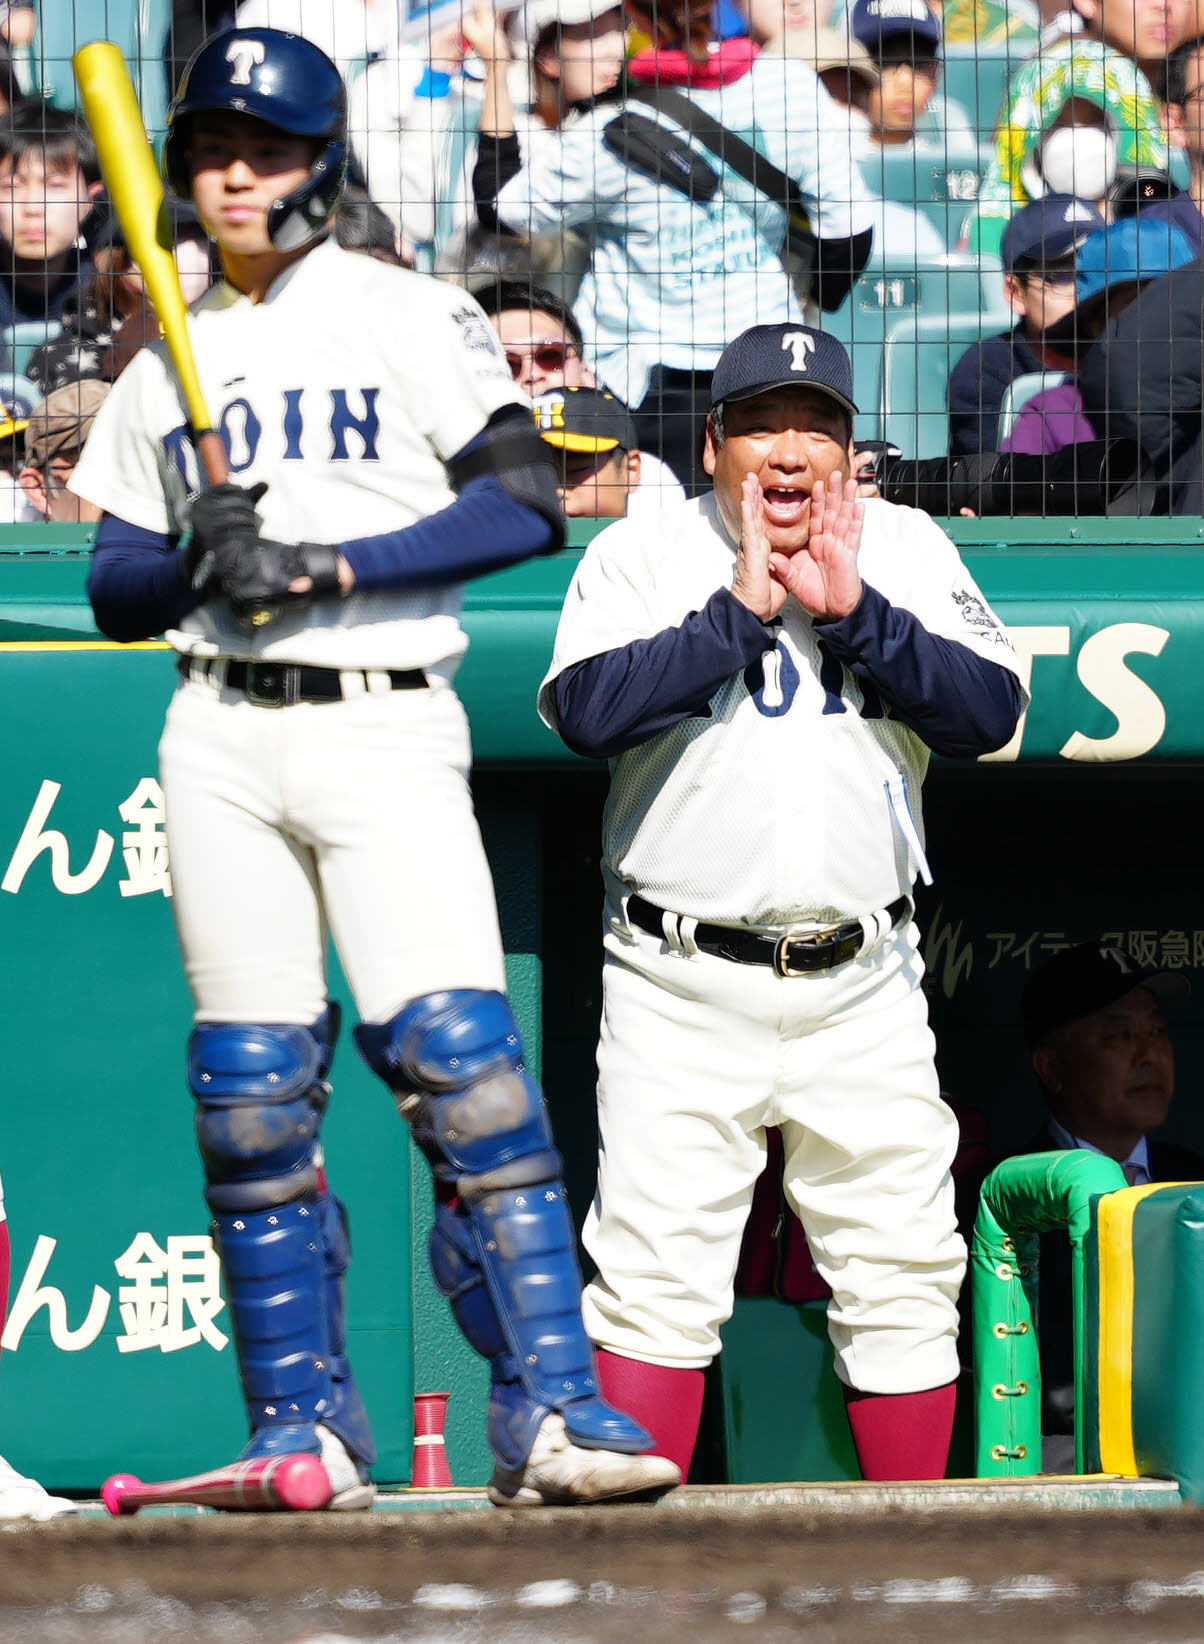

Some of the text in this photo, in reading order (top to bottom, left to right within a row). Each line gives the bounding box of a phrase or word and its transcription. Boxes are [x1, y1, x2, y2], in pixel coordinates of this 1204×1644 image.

[226, 39, 265, 85] T
[946, 169, 979, 200] 12
[873, 278, 905, 308] 11
[781, 331, 816, 371] T
[0, 1232, 229, 1353] ん銀
